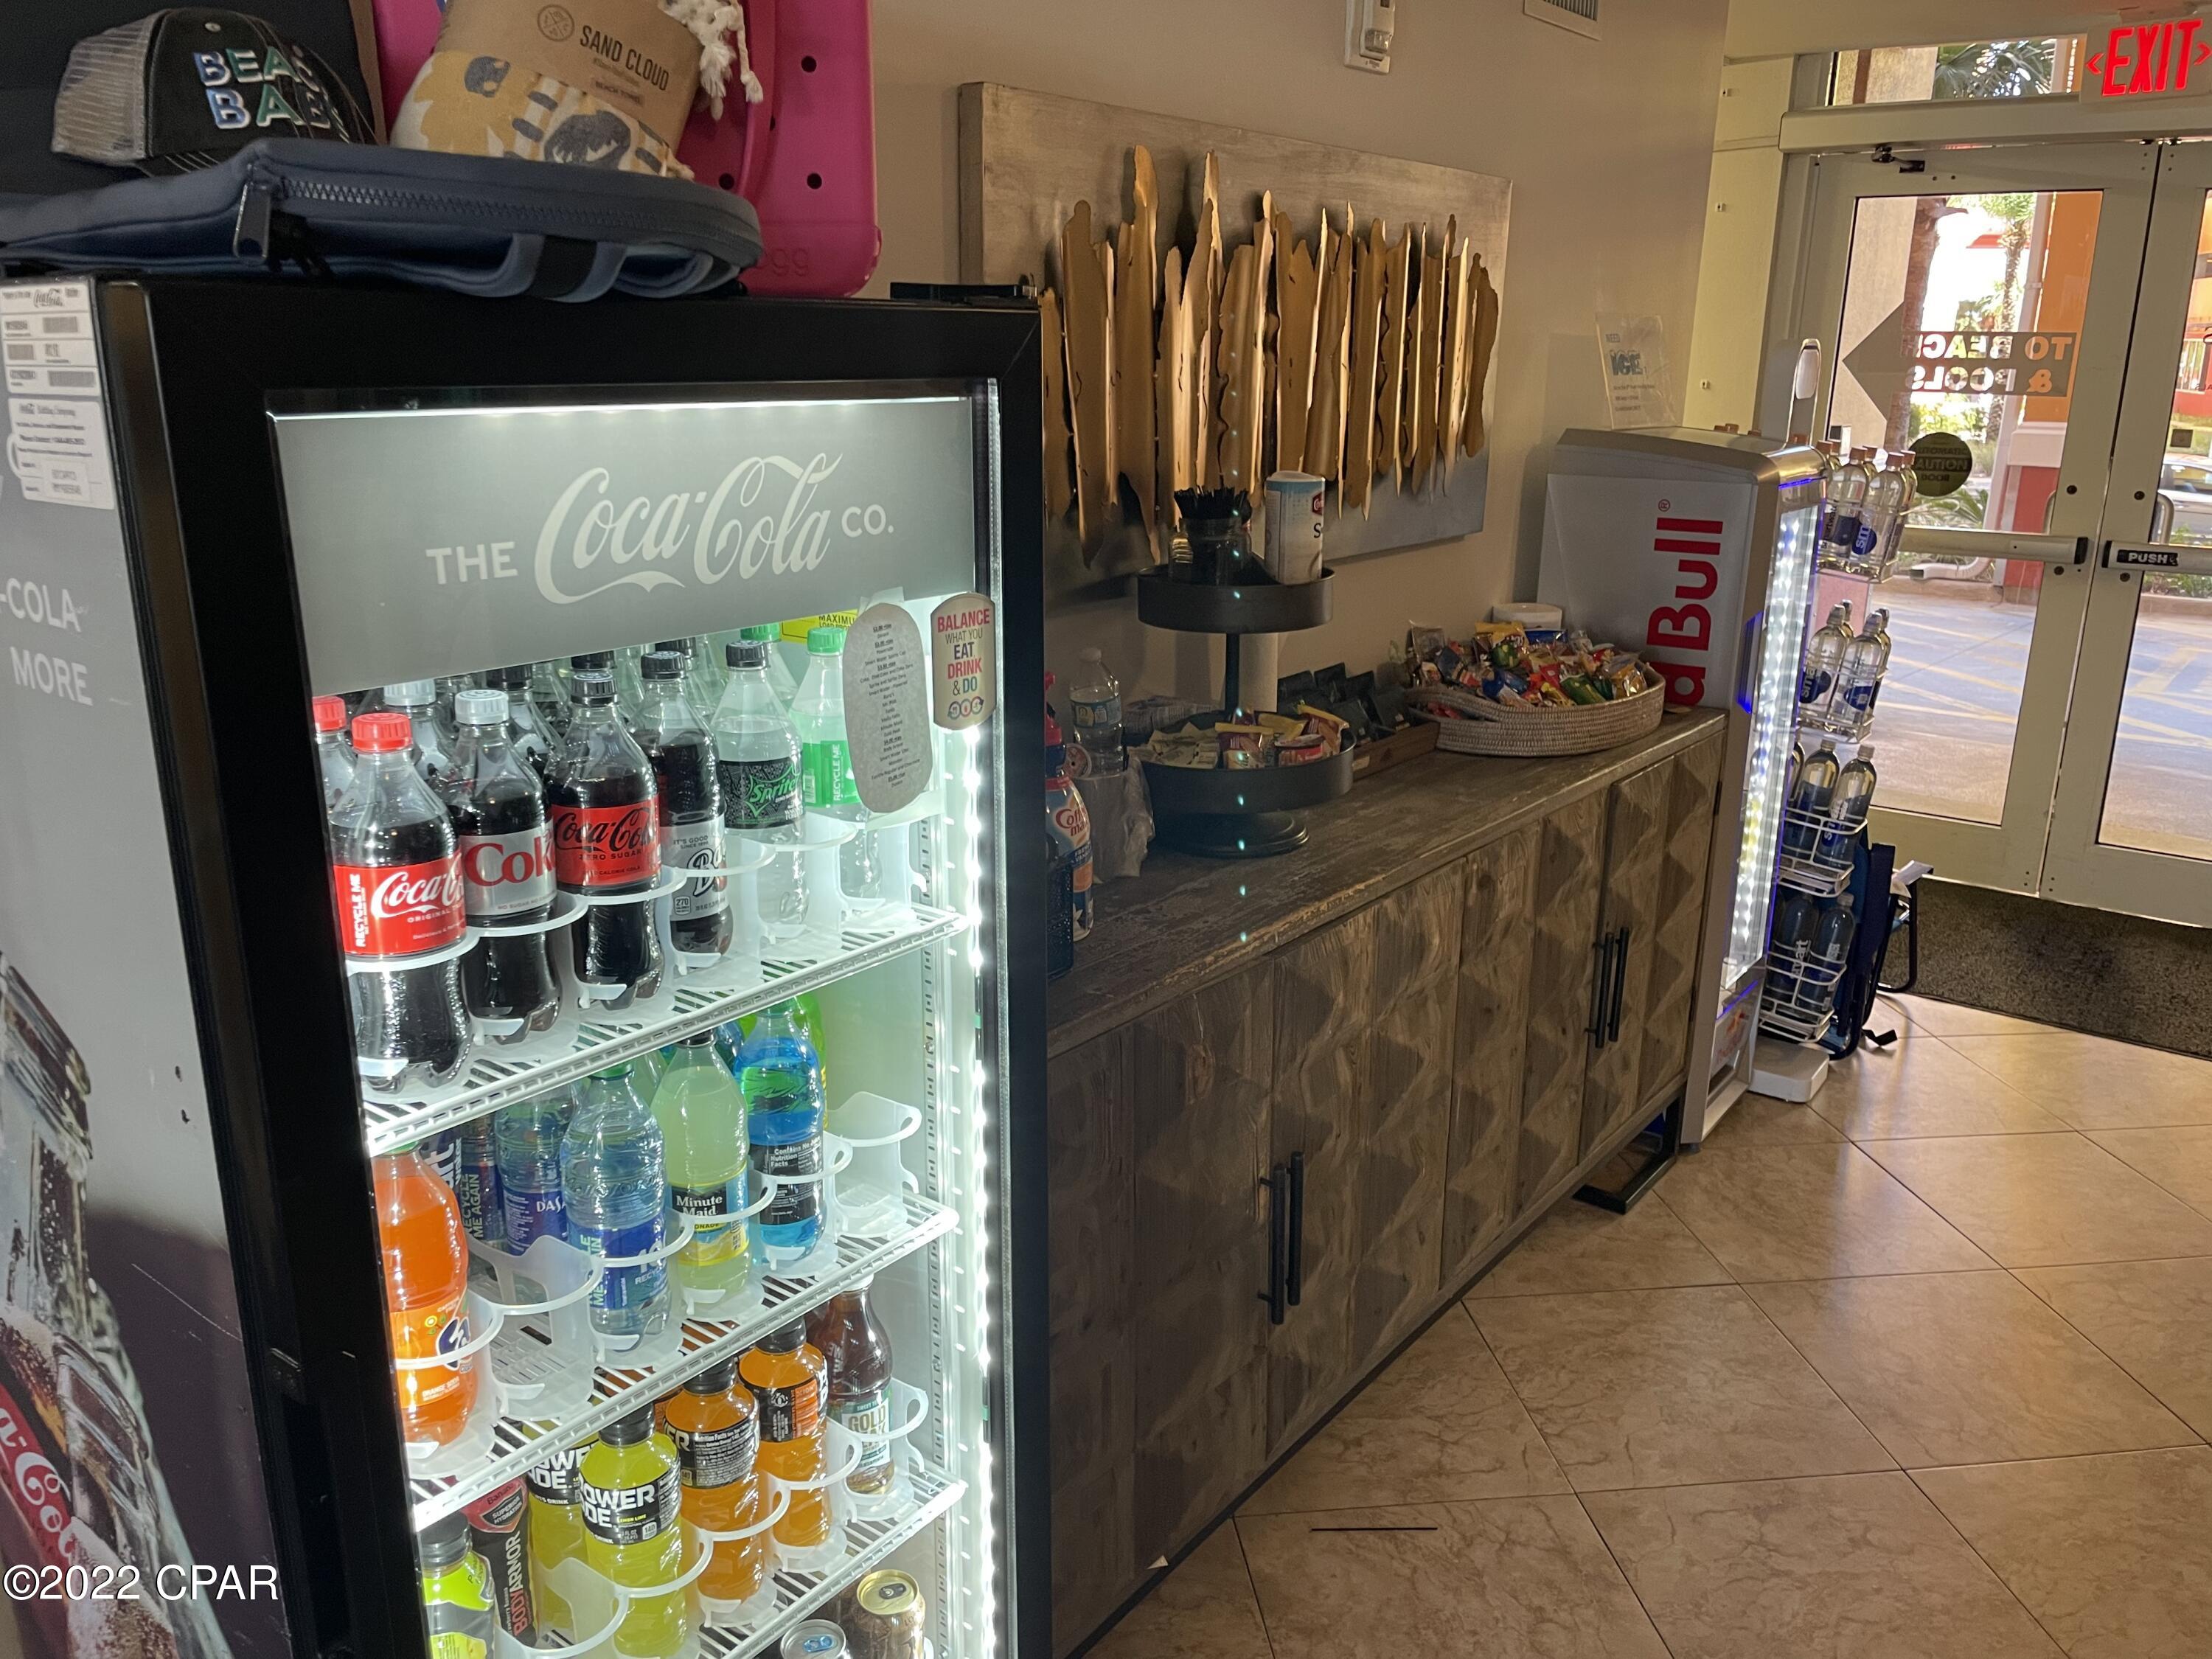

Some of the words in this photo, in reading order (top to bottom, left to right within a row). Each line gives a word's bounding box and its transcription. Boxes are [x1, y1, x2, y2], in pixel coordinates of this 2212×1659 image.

[580, 25, 623, 62] SAND
[625, 49, 669, 91] CLOUD
[2102, 18, 2203, 97] EXIT
[193, 46, 329, 93] BEAC
[1915, 458, 1968, 470] AUTION
[425, 541, 518, 585] THE
[533, 452, 844, 605] Coca-Cola
[842, 504, 894, 538] CO.
[2128, 552, 2168, 564] PUSH
[1646, 517, 1724, 652] Bull
[0, 577, 82, 633] -COLA
[818, 613, 856, 625] MAXIMU
[937, 608, 990, 633] BALANCE
[945, 630, 967, 645] WHAT
[968, 627, 983, 640] YOU
[954, 641, 975, 660] EAT
[10, 646, 94, 706] MORE
[947, 658, 983, 680] DRINK
[953, 680, 961, 696] &
[962, 676, 978, 694] DO
[833, 743, 841, 756] ME
[832, 757, 842, 801] RECYCLE
[749, 778, 796, 804] Sprite
[1055, 807, 1087, 829] Coff
[1071, 821, 1087, 837] ma
[689, 835, 709, 844] GOOD
[464, 835, 556, 887] Cok
[611, 849, 641, 860] SUGAR
[349, 874, 361, 891] ME
[370, 853, 465, 918] Coca-C
[676, 898, 689, 906] 270
[352, 894, 366, 947] RECYCLE
[407, 909, 450, 923] ORIGINAL
[771, 1153, 798, 1161] Nutrition
[469, 1174, 482, 1218] AGAIN
[536, 1195, 567, 1214] DAS
[676, 1194, 723, 1208] Minute
[682, 1205, 717, 1217] Maid
[473, 1218, 484, 1238] ME
[635, 1267, 659, 1285] RECY
[849, 1405, 886, 1432] GOLD
[538, 1445, 593, 1472] OWE
[492, 1496, 521, 1519] SUPERIOR
[580, 1484, 655, 1511] OWER
[493, 1501, 523, 1525] HYDRATION
[581, 1502, 616, 1528] DE.
[644, 1524, 655, 1532] 140
[505, 1530, 529, 1637] BODYARMOR
